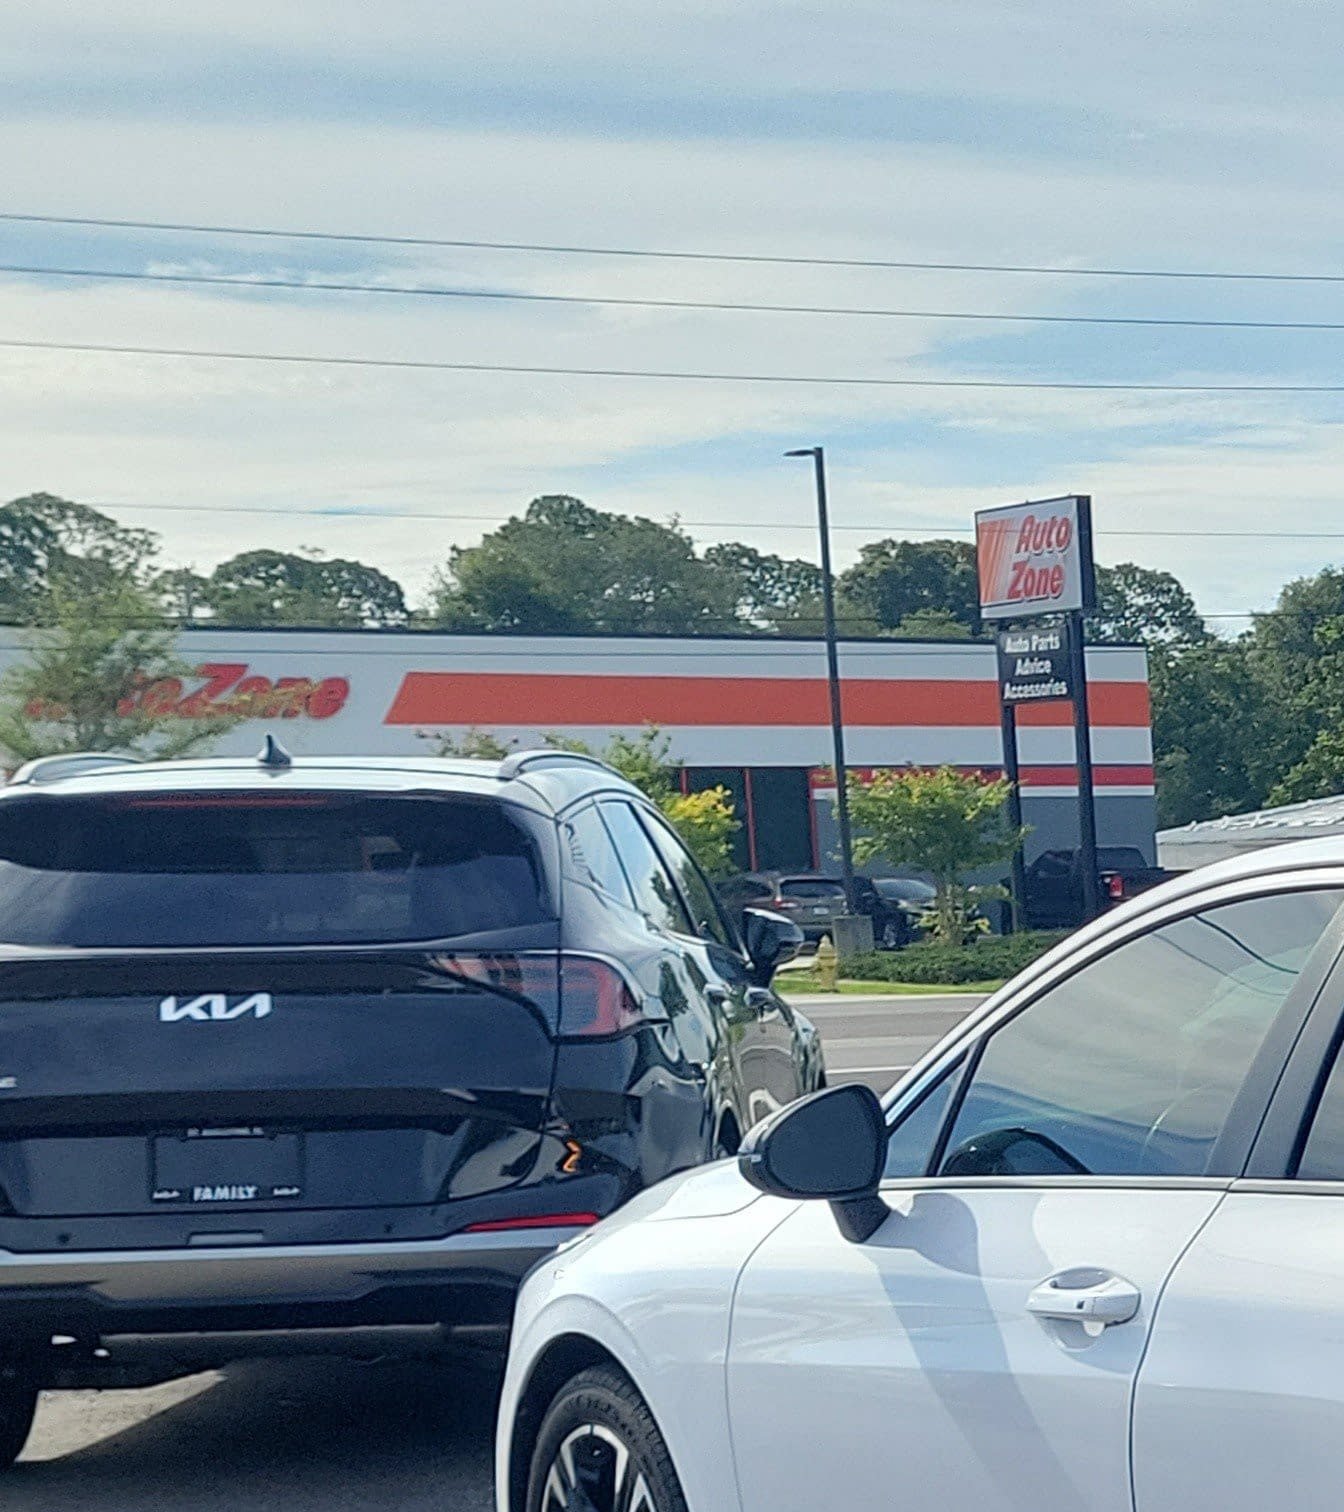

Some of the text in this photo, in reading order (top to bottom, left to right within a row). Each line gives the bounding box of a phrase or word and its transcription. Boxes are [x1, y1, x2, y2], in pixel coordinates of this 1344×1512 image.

[1016, 515, 1072, 555] Auto
[1007, 560, 1065, 601] Zone
[1004, 633, 1061, 654] Auto Parts
[1014, 657, 1052, 676] Advice
[1003, 677, 1068, 700] Accessories
[160, 993, 273, 1022] KIA
[193, 1185, 258, 1201] FAMILY
